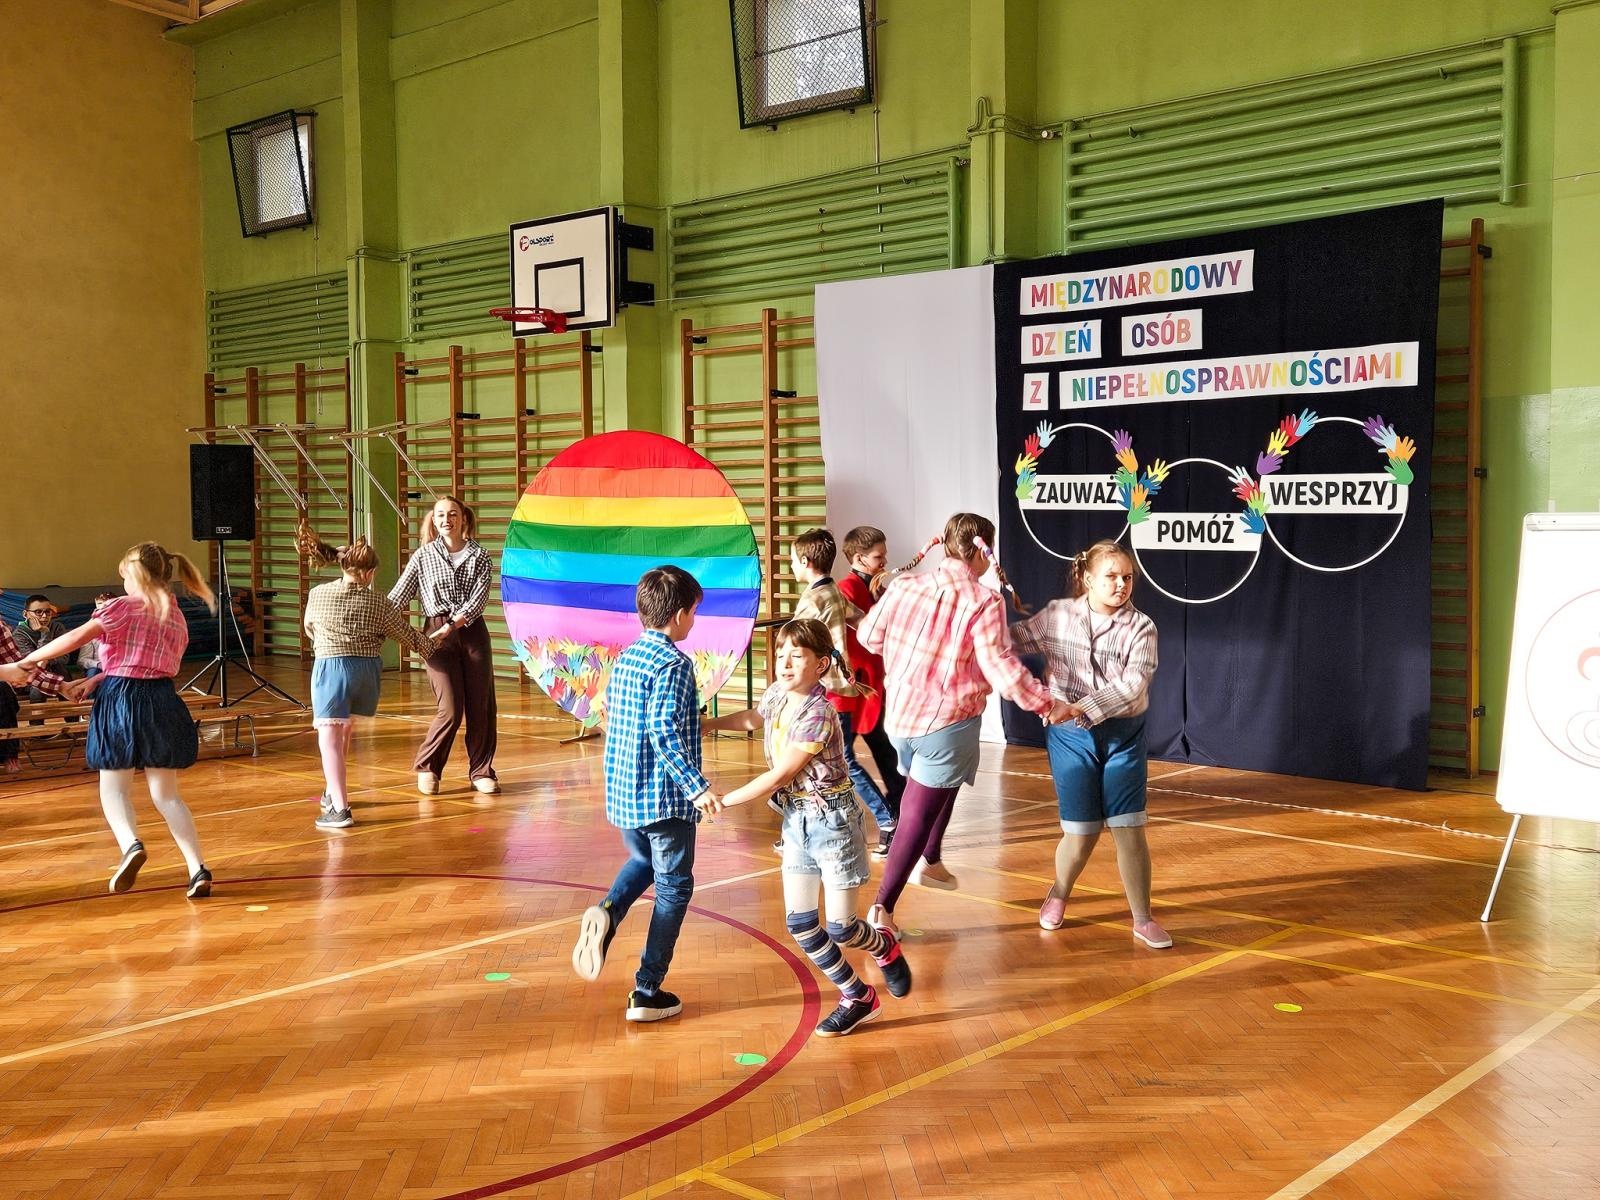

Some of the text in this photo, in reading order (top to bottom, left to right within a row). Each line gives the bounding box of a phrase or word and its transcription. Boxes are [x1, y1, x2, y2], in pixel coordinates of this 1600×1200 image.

[1031, 259, 1243, 310] MIĘDZYNARODOWY
[1031, 313, 1192, 357] DZIEŃ OSÓB
[1029, 351, 1403, 404] Z NIEPEŁNOSPRAWNOŚCIAMI
[1036, 475, 1117, 504] ZAUWAŻ
[1269, 480, 1398, 511] WESPRZYJ
[1156, 513, 1235, 544] POMÓŻ
